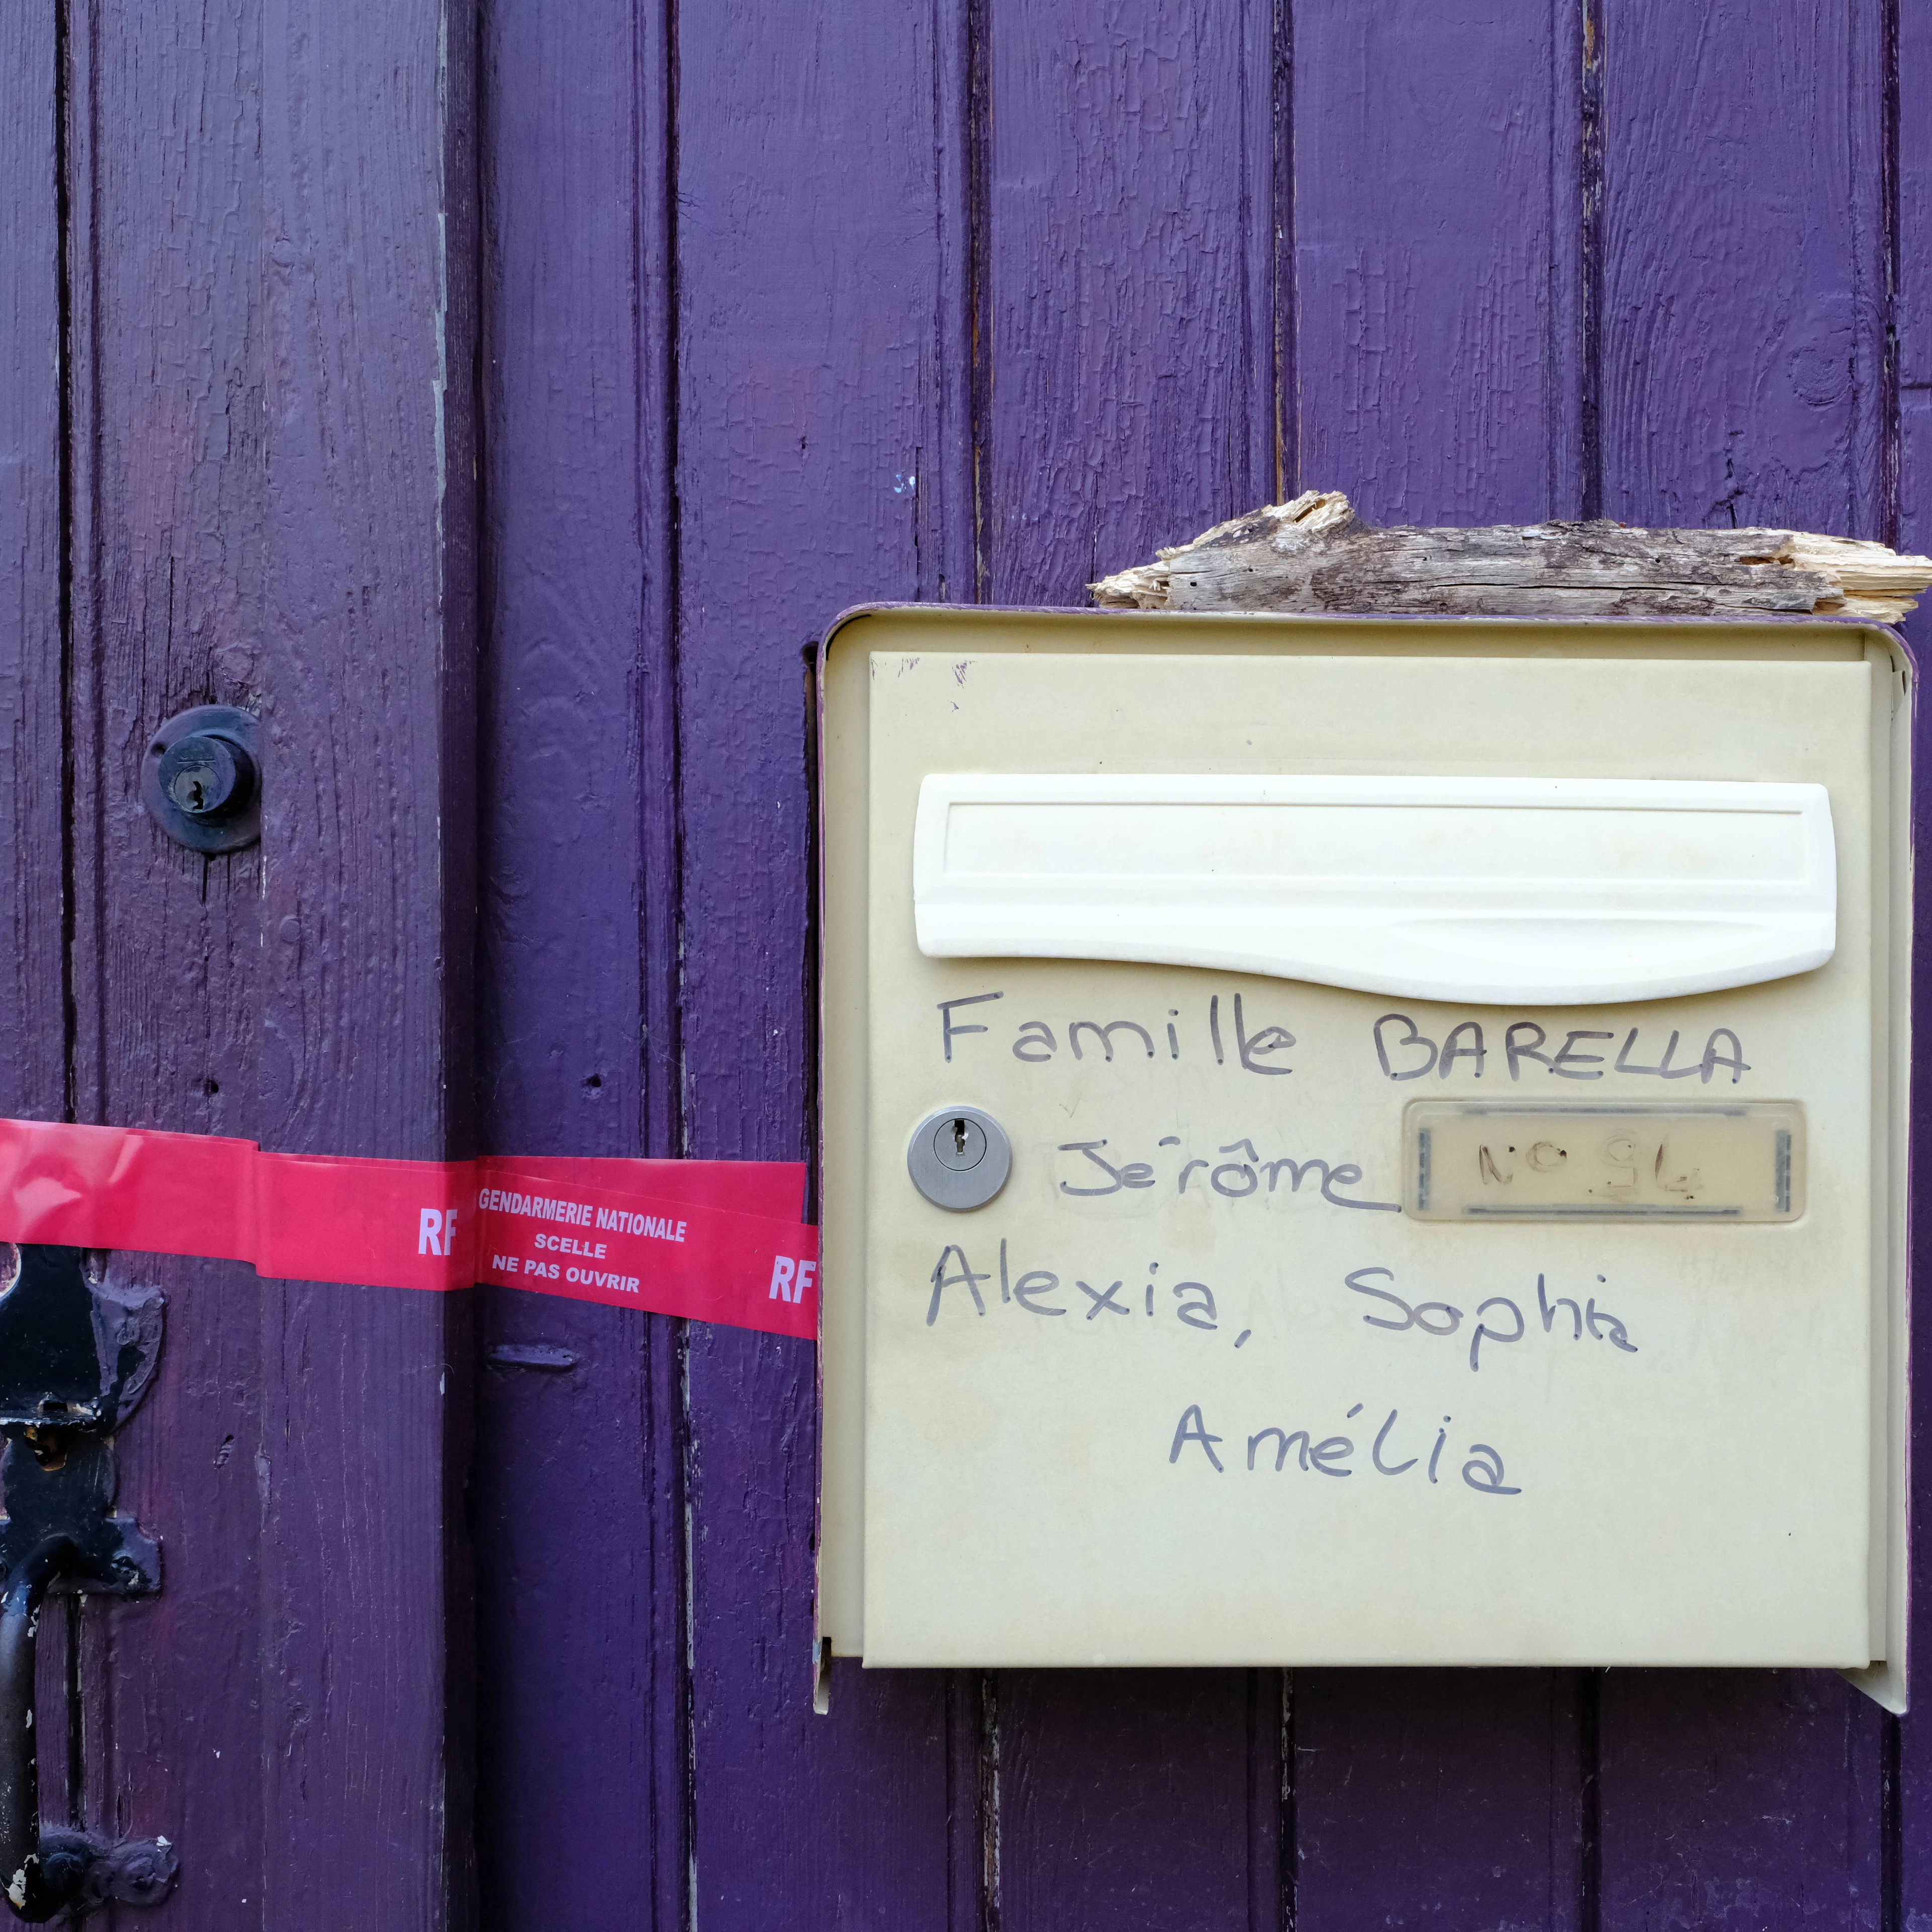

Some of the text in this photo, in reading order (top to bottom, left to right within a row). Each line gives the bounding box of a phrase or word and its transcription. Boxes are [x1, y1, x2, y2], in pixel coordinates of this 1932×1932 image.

[937, 990, 1751, 1084] Famille BARELLA
[1058, 1136, 1402, 1213] Jérôme
[417, 1208, 457, 1256] RF
[478, 1188, 687, 1243] GENDARMERIE NATIONALE
[534, 1233, 607, 1259] SCELLE
[493, 1254, 640, 1293] NE PAS OUVRIR
[768, 1255, 817, 1304] RF
[926, 1237, 1252, 1349] Alexia,
